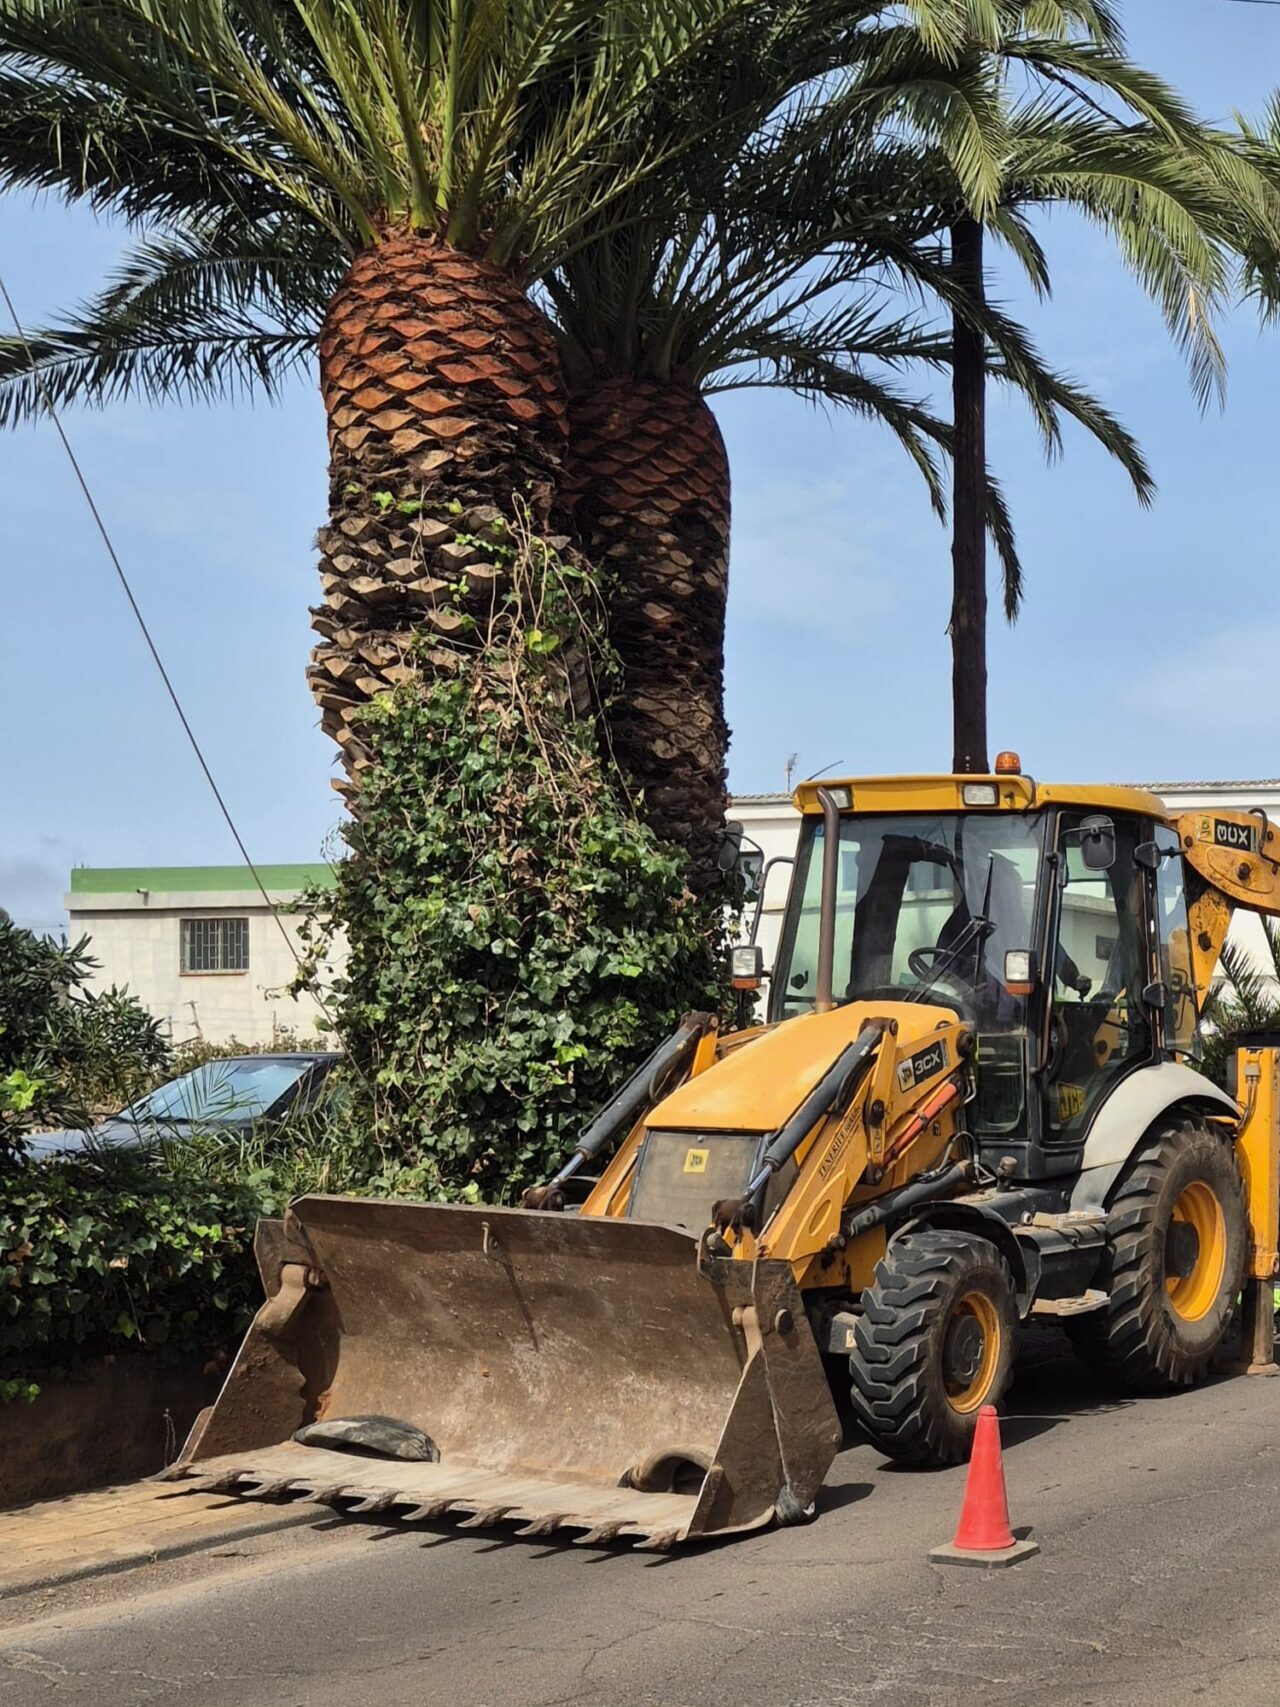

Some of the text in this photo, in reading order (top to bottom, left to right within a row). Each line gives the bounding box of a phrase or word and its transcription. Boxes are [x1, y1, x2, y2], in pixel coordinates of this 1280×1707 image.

[1217, 824, 1248, 846] 3CX
[914, 1049, 941, 1075] 3CX
[1060, 1087, 1086, 1119] JCB
